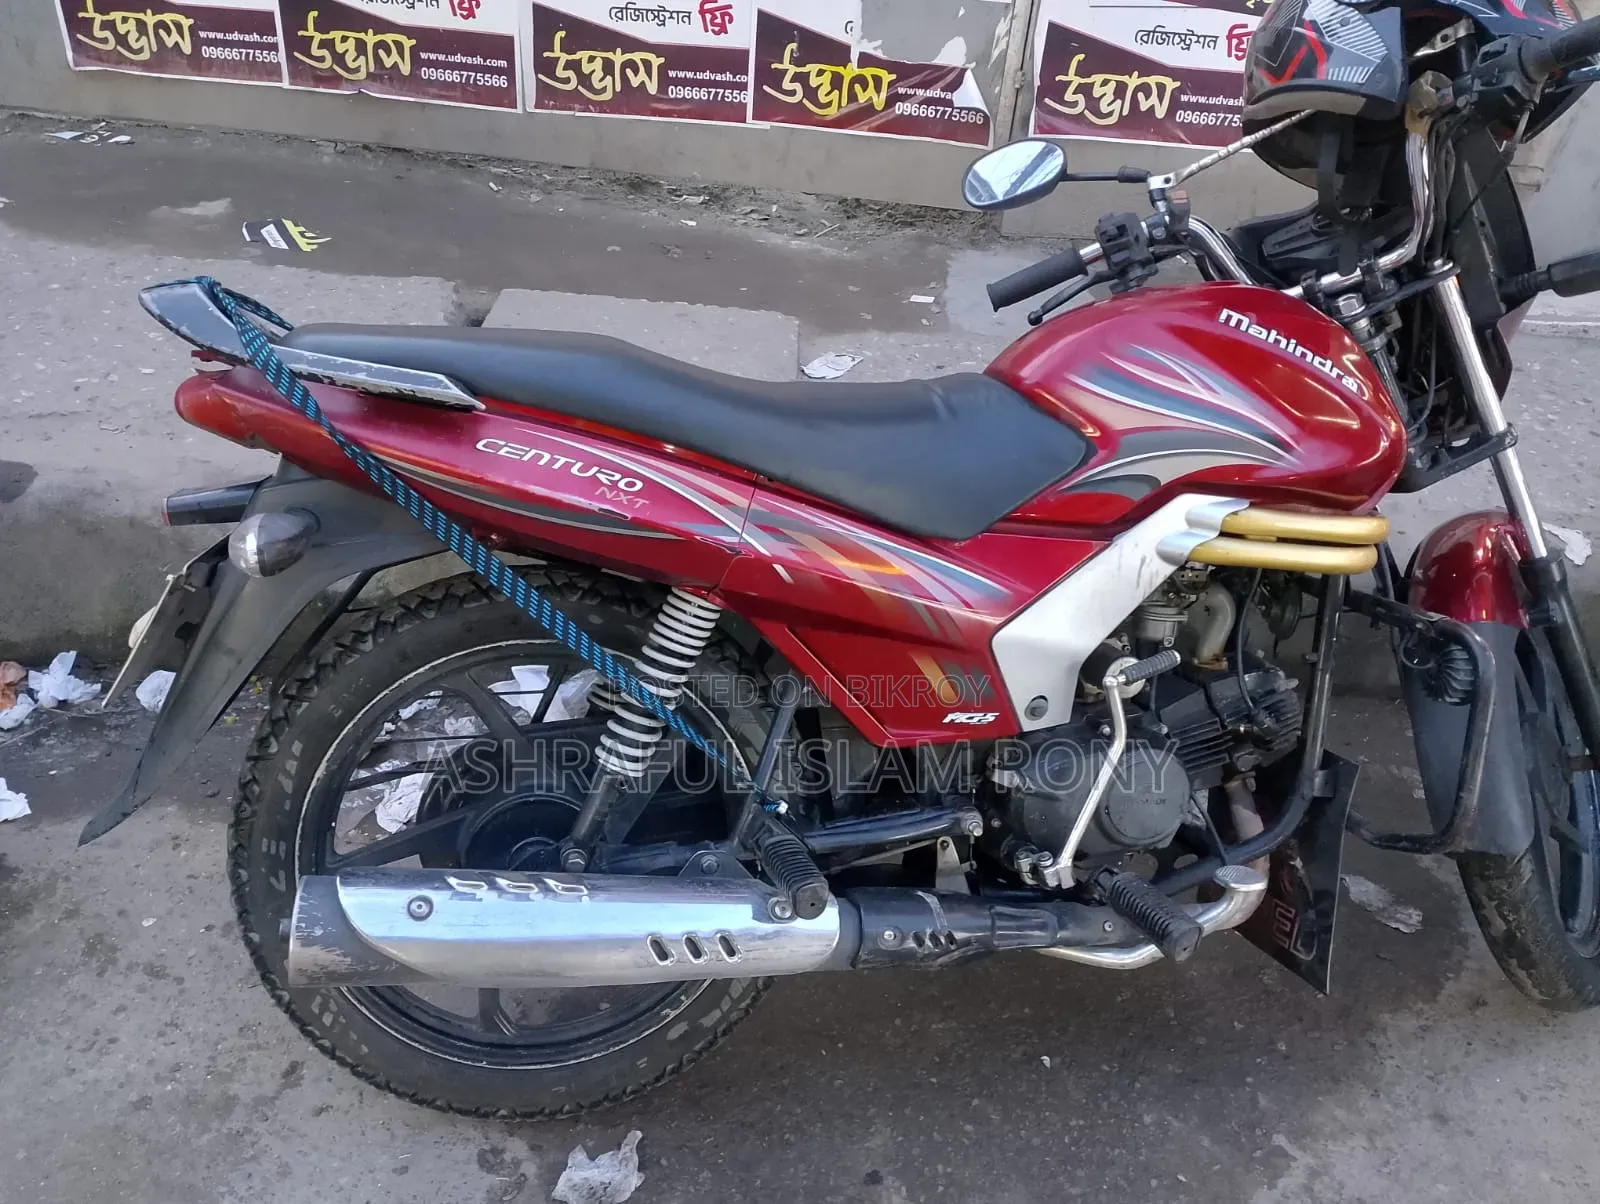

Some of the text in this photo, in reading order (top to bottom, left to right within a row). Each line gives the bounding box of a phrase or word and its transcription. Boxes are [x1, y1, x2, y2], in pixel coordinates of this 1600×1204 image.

[609, 0, 734, 35] রেজিস্ট্রেশন ফ্রি
[293, 10, 416, 81] উদ্ভাস
[1134, 24, 1219, 52] রেজিস্ট্রেশন
[201, 45, 281, 63] 0966677556
[420, 50, 508, 69] www.udvash.com
[537, 30, 666, 101] উদ্ভাস
[421, 67, 508, 88] 09666775566
[1044, 53, 1181, 126] উদ্ভাস
[895, 101, 985, 125] 09666775566
[1175, 109, 1243, 128] 09666775
[1217, 307, 1359, 394] Mahindra
[474, 437, 645, 493] CENTURO
[595, 485, 650, 510] NXT
